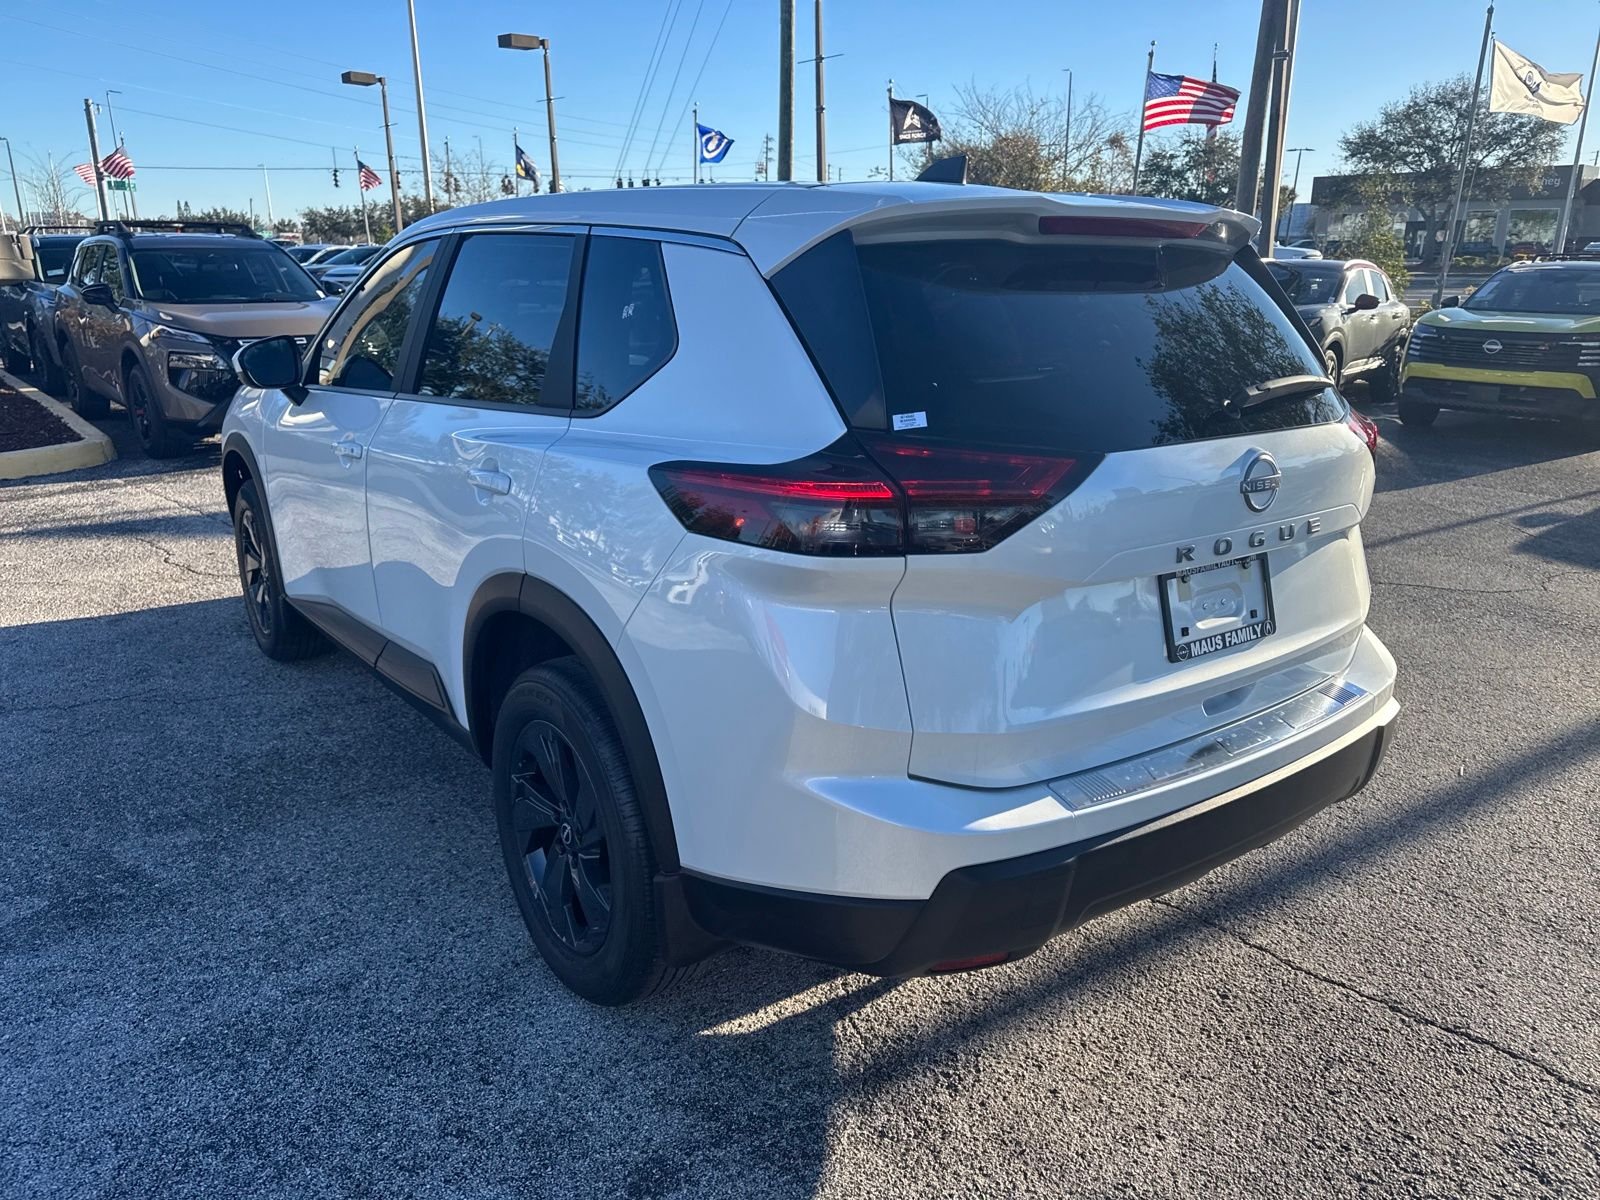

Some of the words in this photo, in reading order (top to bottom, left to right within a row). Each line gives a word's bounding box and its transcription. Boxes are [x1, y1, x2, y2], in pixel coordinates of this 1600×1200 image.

[1176, 517, 1321, 563] ROGUE
[1175, 554, 1257, 577] MAUSFAMILYAUTO.om
[1190, 634, 1223, 657] MAUS
[1225, 623, 1262, 647] FAMILY
